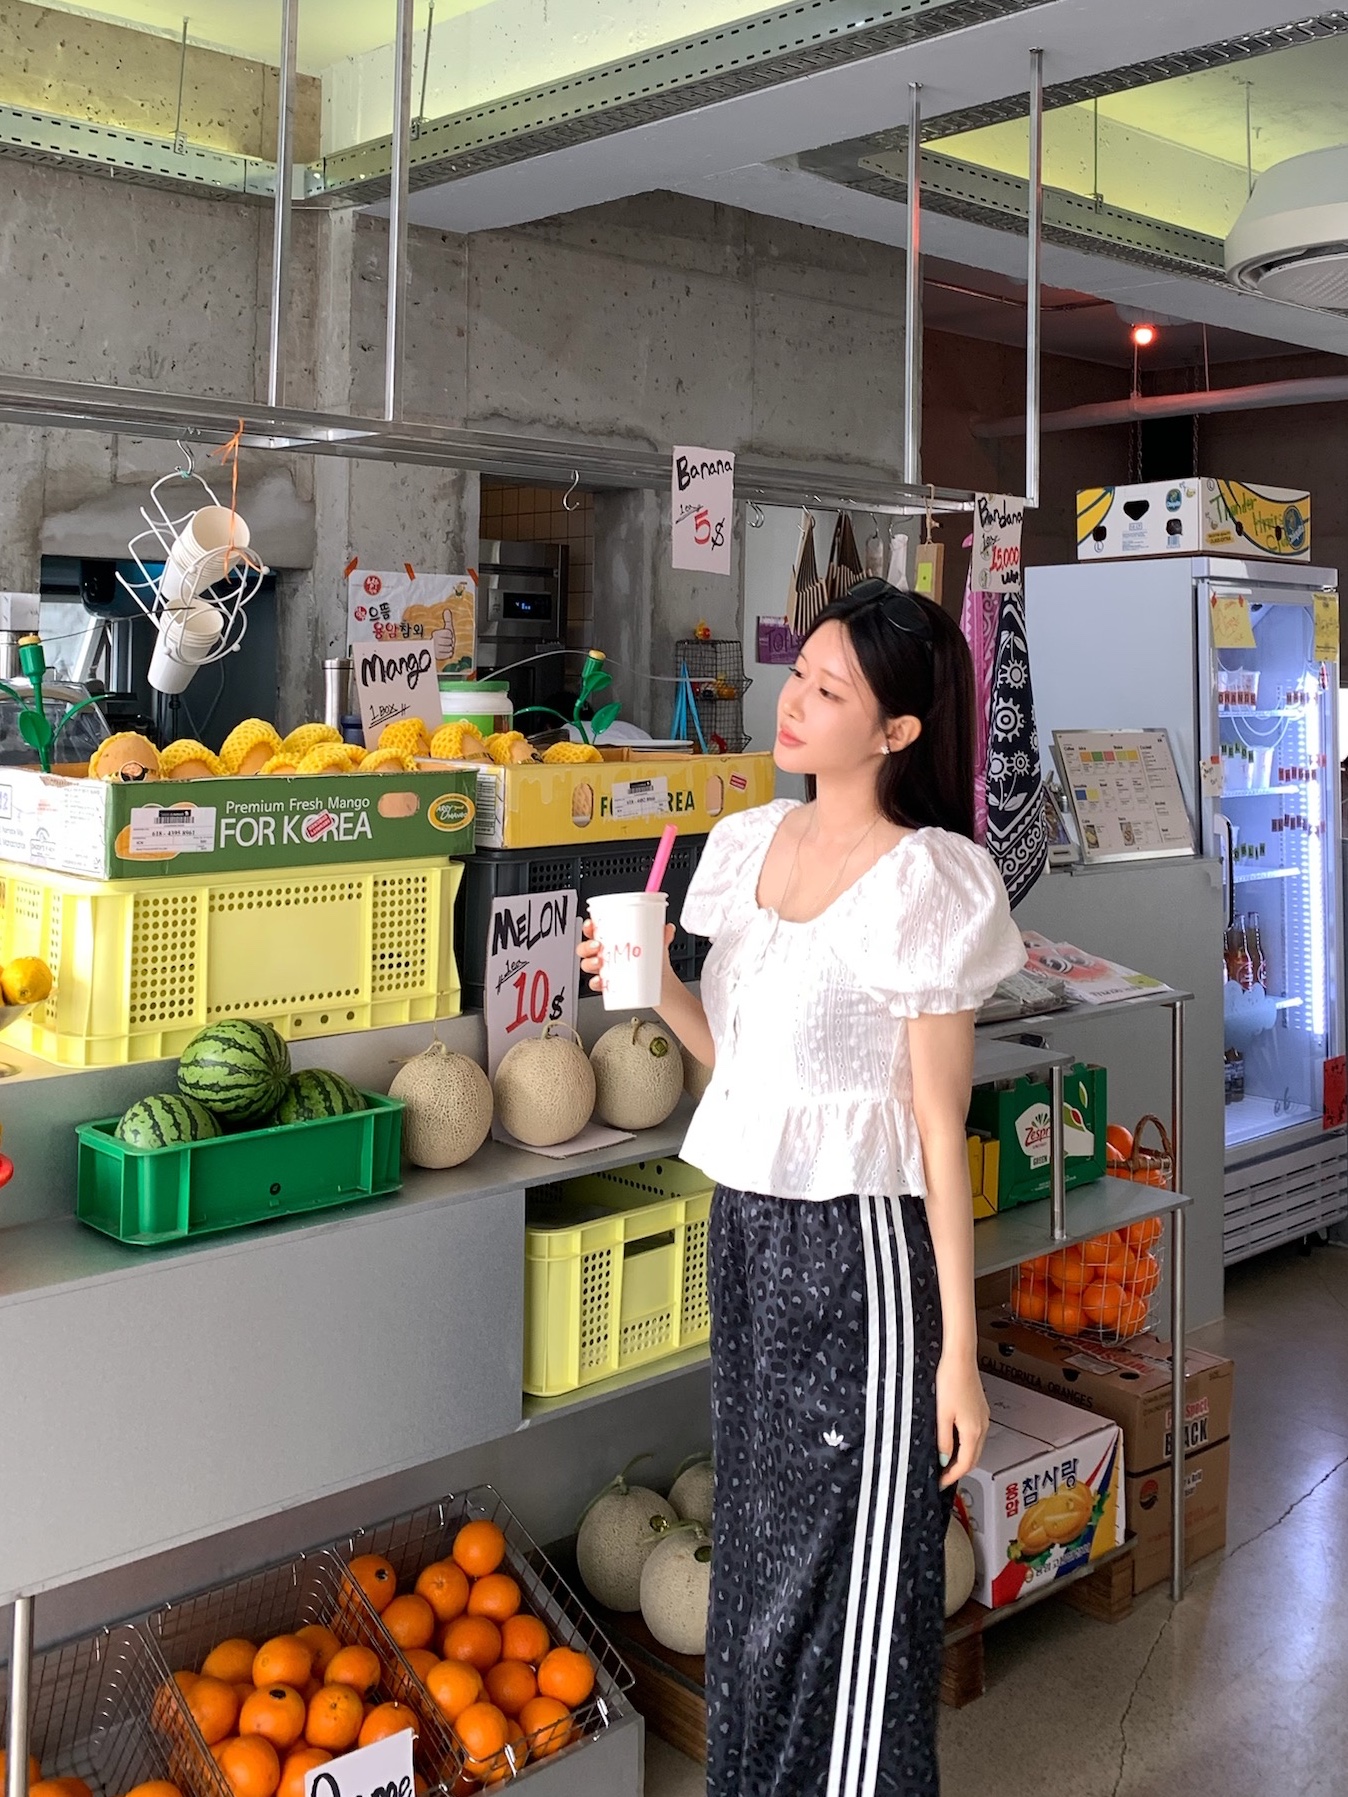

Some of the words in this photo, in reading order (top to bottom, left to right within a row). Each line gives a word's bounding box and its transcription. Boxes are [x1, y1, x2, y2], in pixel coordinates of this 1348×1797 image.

[676, 455, 733, 491] Banana
[361, 648, 432, 690] Mango
[226, 800, 285, 814] Premium
[289, 797, 323, 811] Fresh
[327, 796, 370, 811] Mango
[220, 816, 276, 849] FOR
[283, 811, 373, 844] KOREA
[491, 895, 568, 956] MELON
[1025, 1127, 1051, 1148] Zespr
[1032, 1155, 1048, 1166] GREEN
[981, 1355, 1042, 1389] CALIFORNIA
[1047, 1381, 1094, 1409] ORANGES
[1005, 1483, 1019, 1519] 용암
[1022, 1458, 1080, 1510] 참사랑
